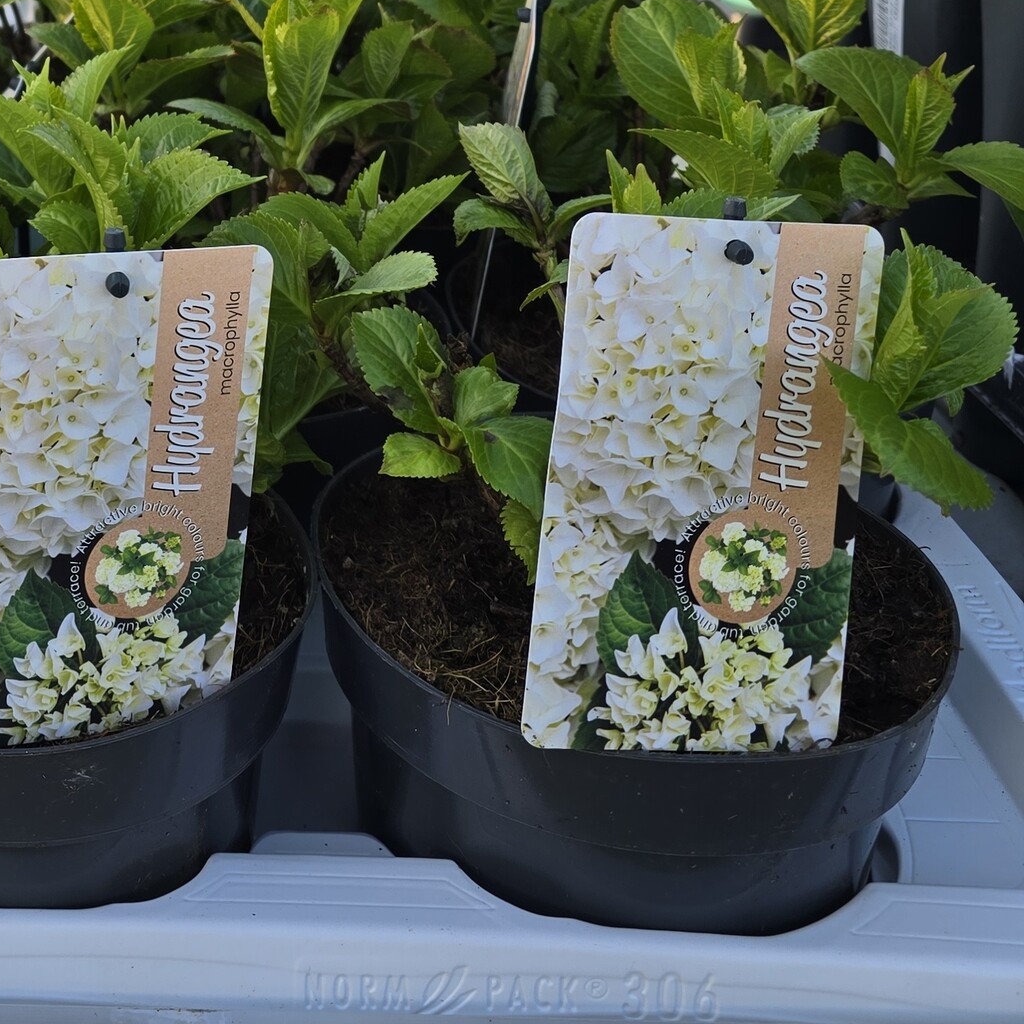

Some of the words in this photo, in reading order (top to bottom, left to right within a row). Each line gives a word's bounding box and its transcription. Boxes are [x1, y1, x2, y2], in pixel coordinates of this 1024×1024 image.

[220, 291, 243, 395] macrophylla
[829, 273, 853, 385] acrophylla
[151, 290, 224, 497] Hydrangea
[758, 269, 834, 492] Hydrangea
[76, 504, 137, 554] Attractive
[141, 500, 184, 520] bright
[681, 493, 743, 542] Attractive
[748, 491, 790, 518] bright
[181, 517, 205, 563] colours
[787, 515, 811, 570] colours
[69, 561, 89, 615] terrace!
[191, 566, 206, 586] for
[674, 549, 692, 611] terrace!
[796, 574, 811, 597] for
[85, 612, 113, 629] and
[116, 621, 140, 633] tub
[687, 611, 717, 634] and
[719, 626, 744, 639] tub
[304, 972, 411, 1011] NORM
[622, 971, 720, 1022] 306
